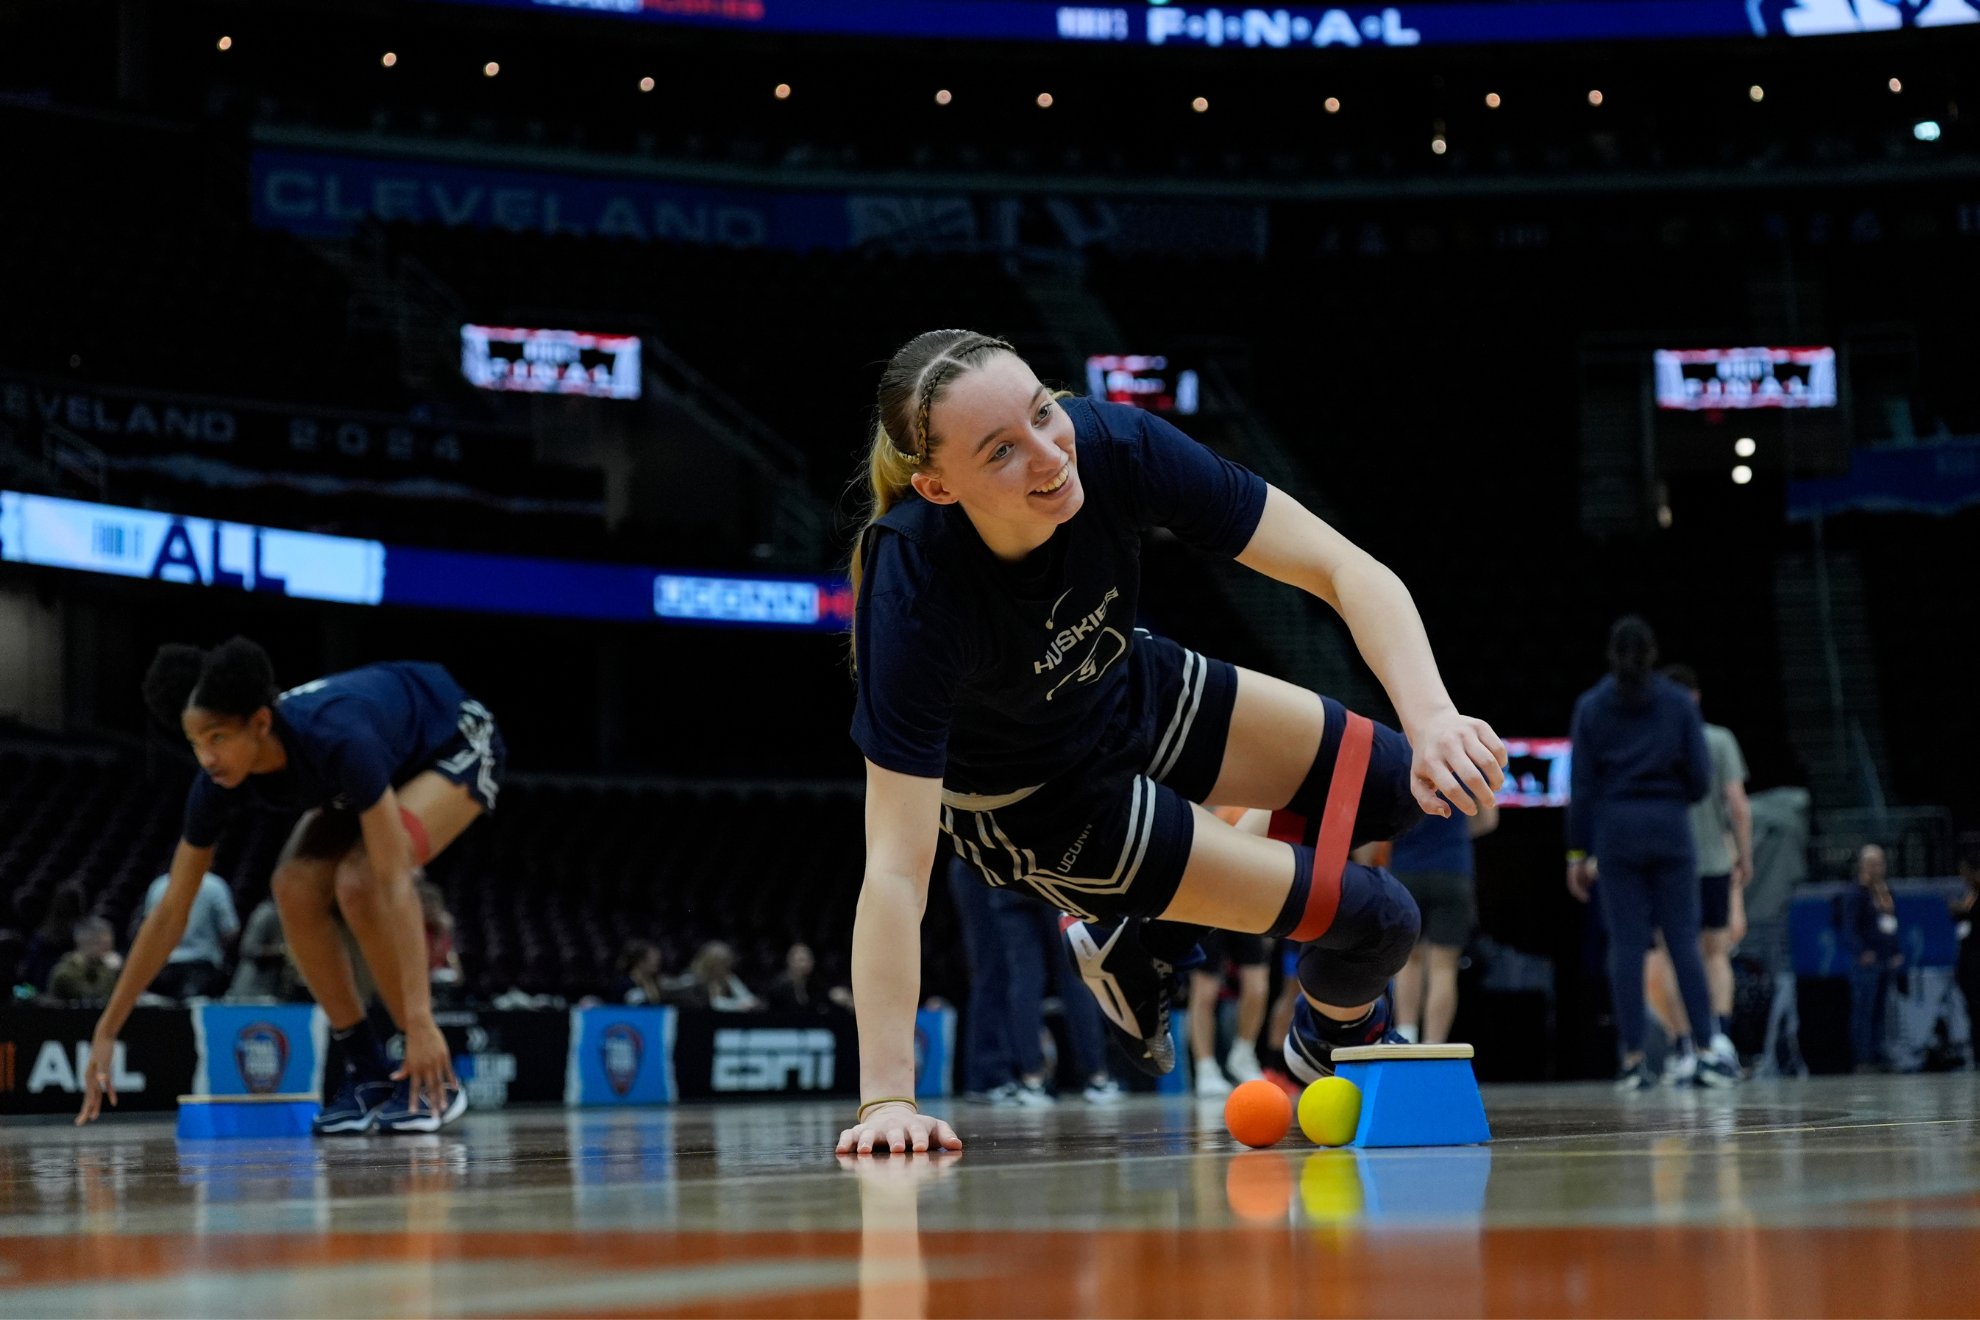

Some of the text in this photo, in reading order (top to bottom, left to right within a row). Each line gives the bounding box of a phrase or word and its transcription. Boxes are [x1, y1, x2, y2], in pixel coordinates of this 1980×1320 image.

[264, 168, 767, 249] CLEVELAND
[150, 514, 286, 593] ALL
[711, 1029, 836, 1091] ESPN
